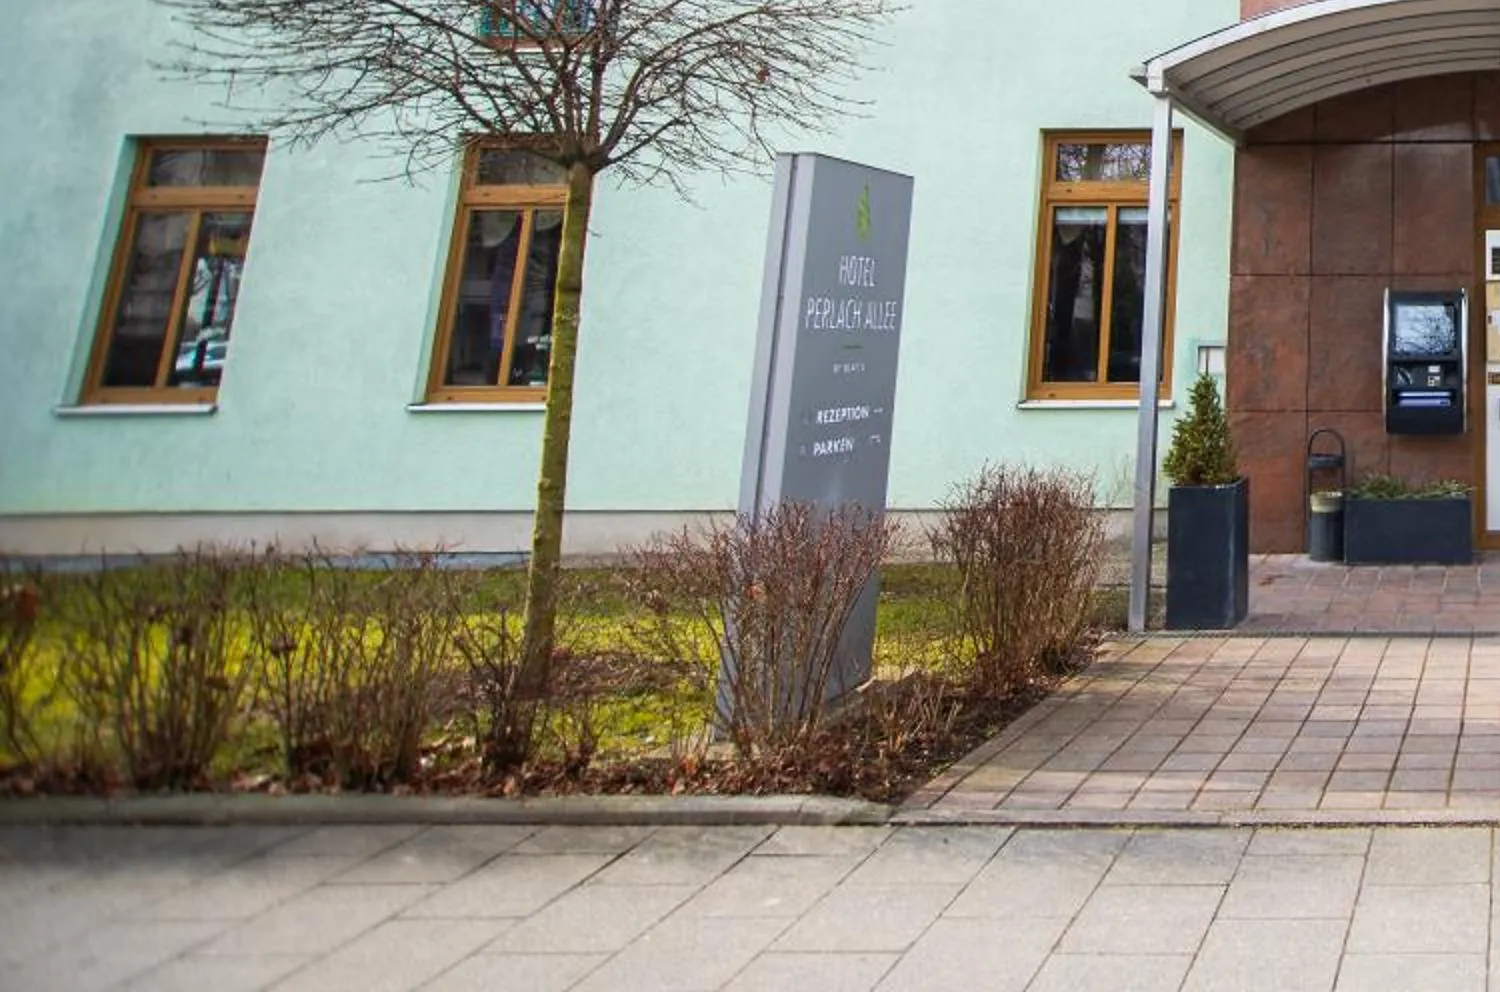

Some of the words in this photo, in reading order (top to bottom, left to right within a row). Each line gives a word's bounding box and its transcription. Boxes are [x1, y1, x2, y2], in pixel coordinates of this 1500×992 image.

[839, 255, 876, 287] HOTEL
[805, 297, 862, 329] PERLACH
[863, 301, 897, 330] ALLEE
[816, 405, 870, 424] REZEPTION
[813, 437, 854, 456] PARKEN
